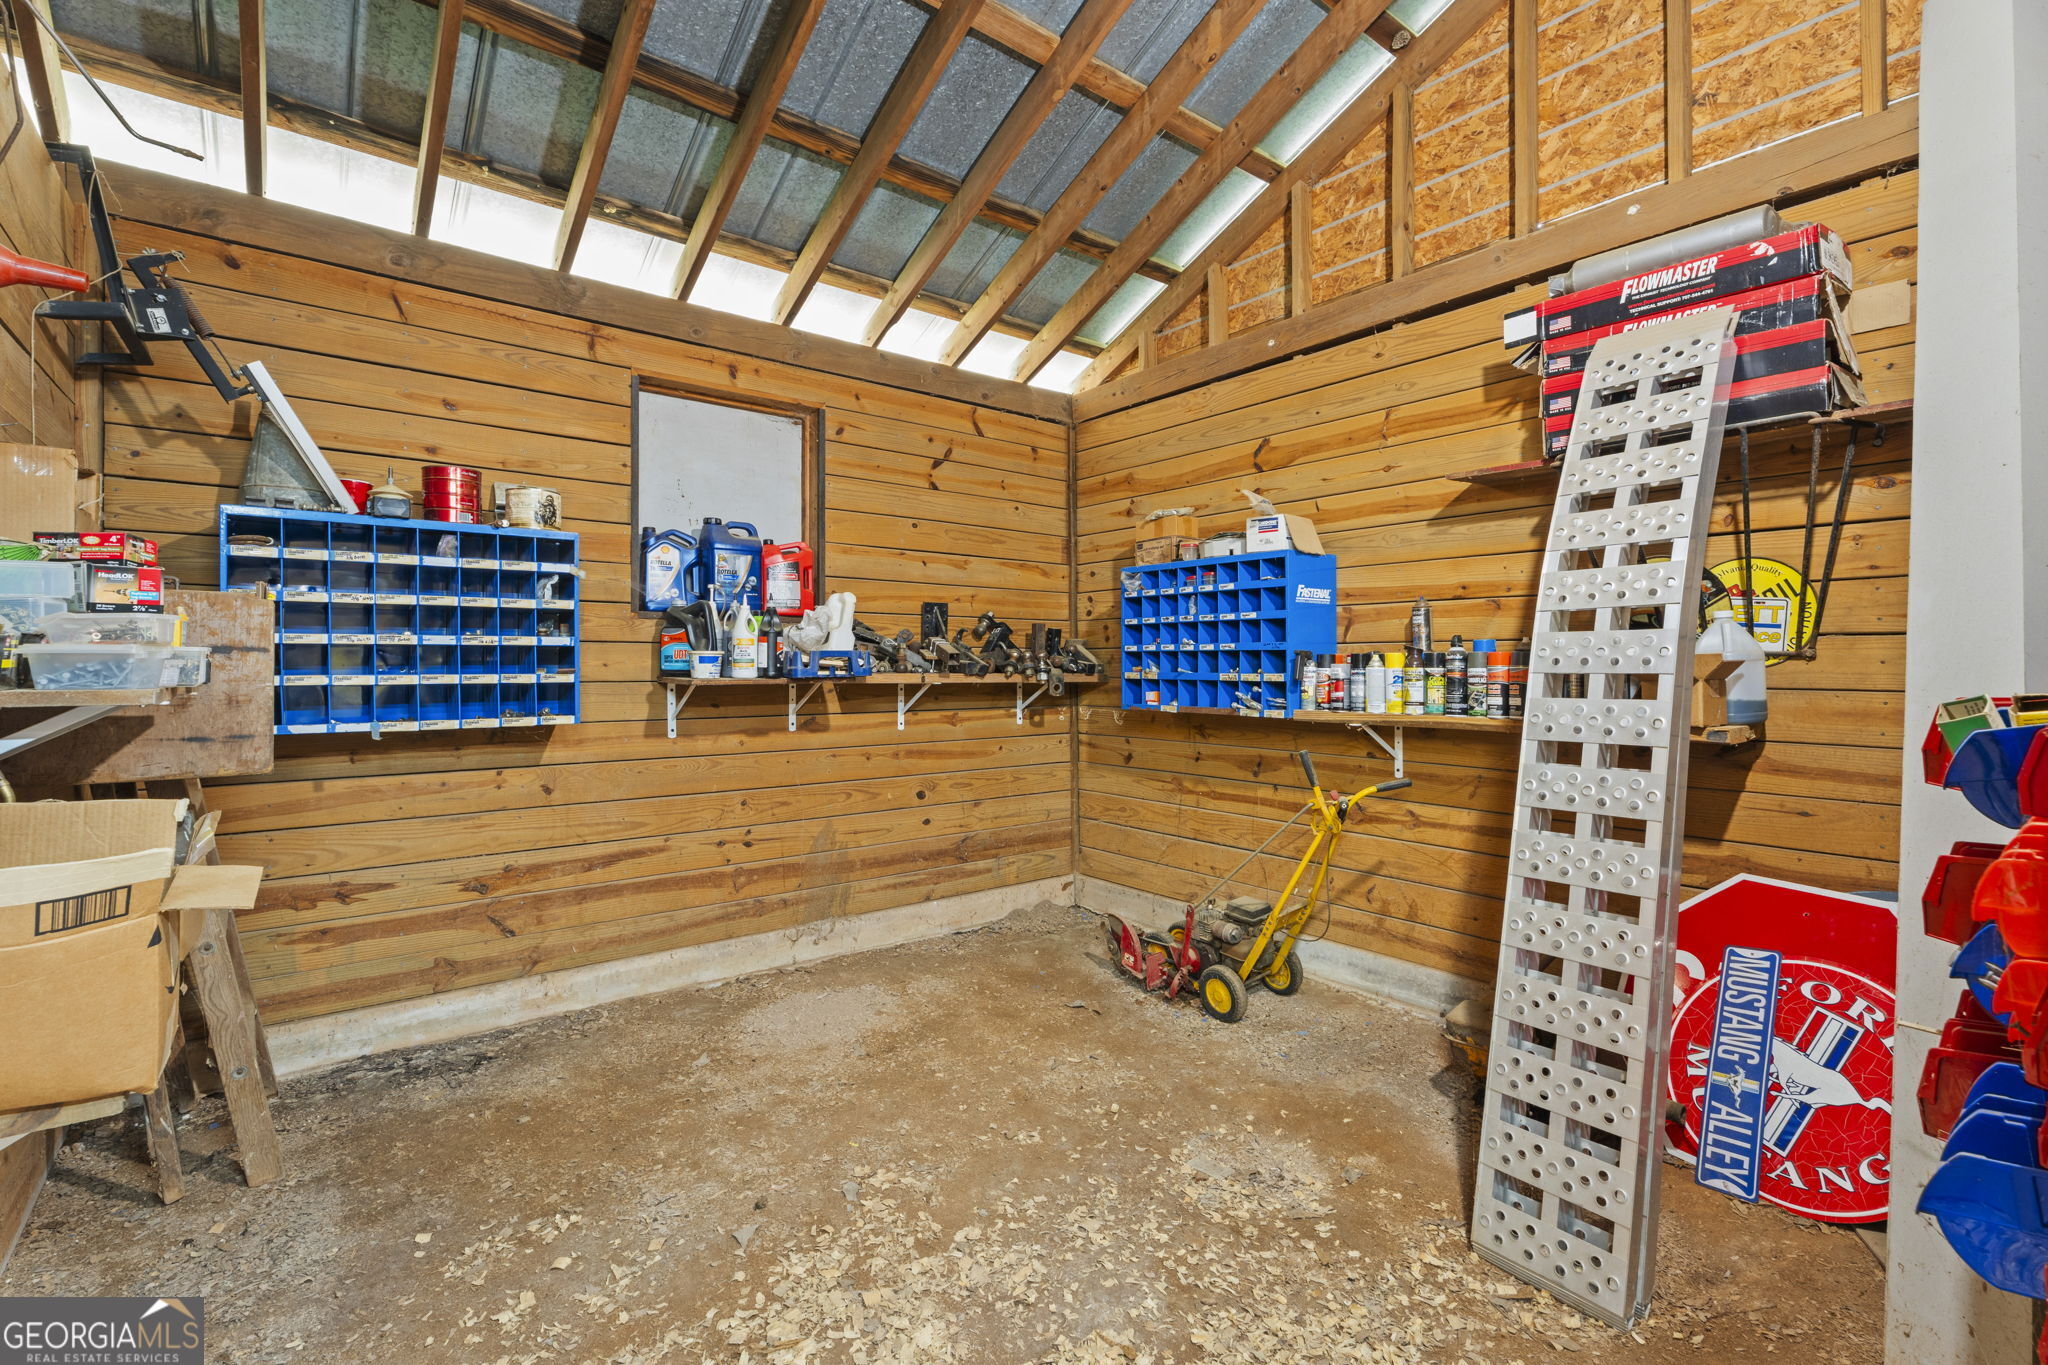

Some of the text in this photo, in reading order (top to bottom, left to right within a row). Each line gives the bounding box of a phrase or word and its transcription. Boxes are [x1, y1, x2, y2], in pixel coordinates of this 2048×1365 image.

[1619, 256, 1719, 304] FLOWMASTER
[1629, 303, 1657, 313] TECHNICAL
[39, 537, 80, 545] TimberLOK
[97, 571, 135, 579] HeadLOK
[1751, 562, 1784, 578] Quality
[1296, 584, 1331, 599] FASTENAL
[1717, 955, 1771, 1065] MUSTANG
[1704, 1099, 1754, 1188] ALLEY
